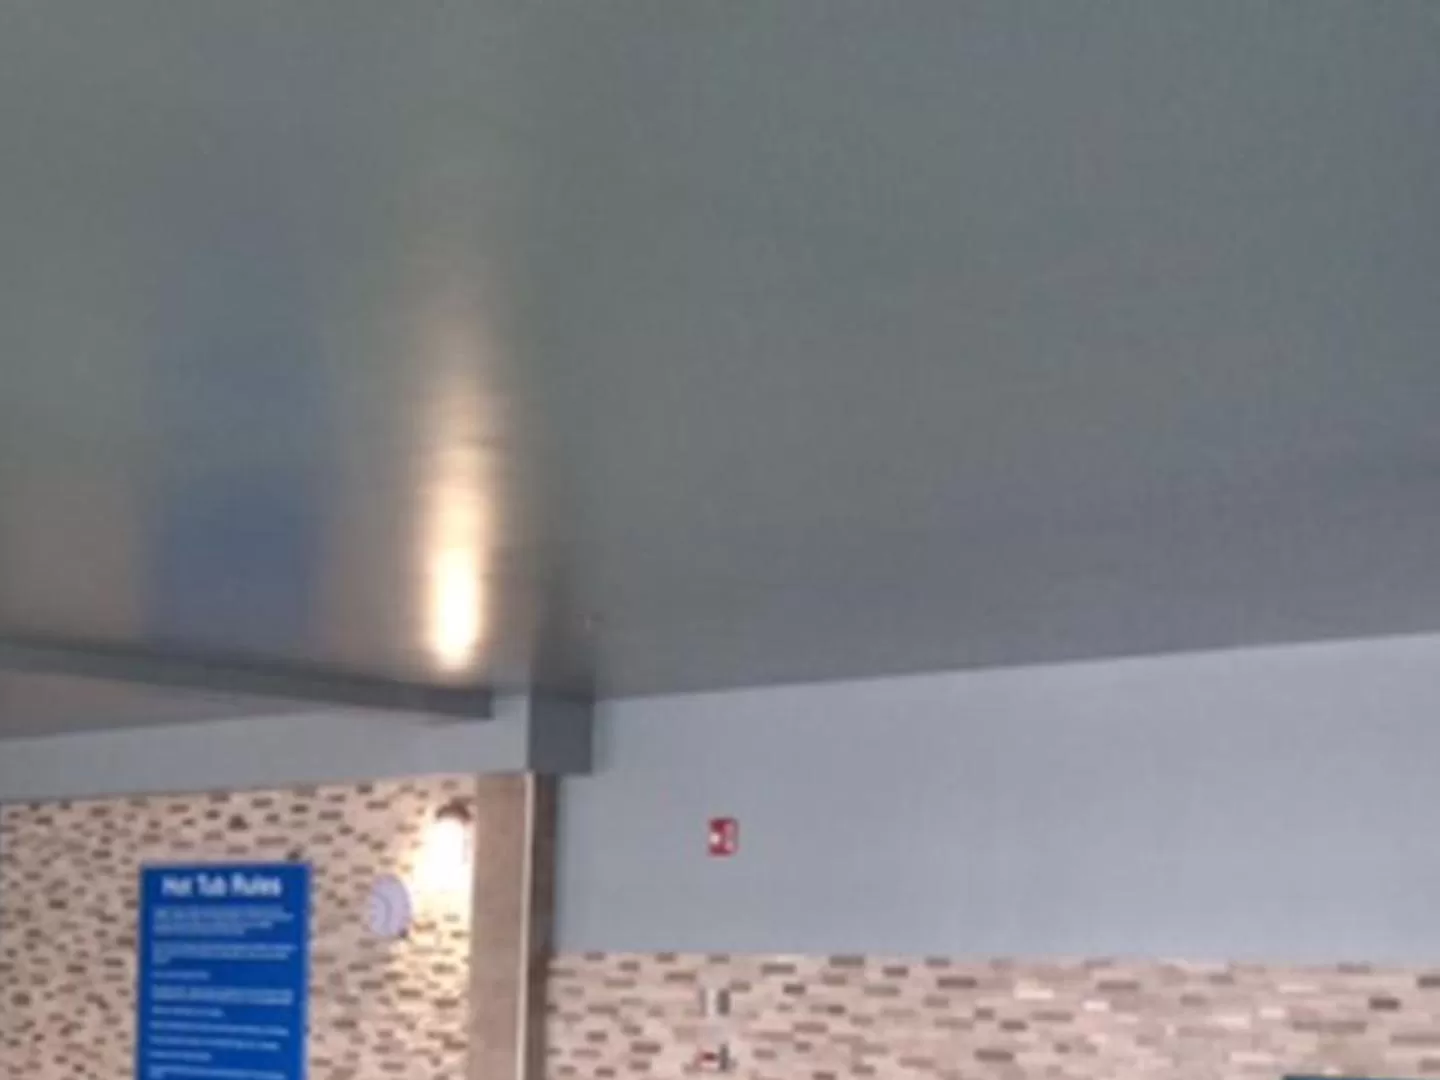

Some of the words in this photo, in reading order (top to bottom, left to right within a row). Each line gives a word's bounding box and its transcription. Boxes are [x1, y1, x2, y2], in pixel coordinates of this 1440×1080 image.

[162, 874, 192, 897] Hot
[197, 872, 227, 897] Tub
[231, 872, 281, 897] Rules
